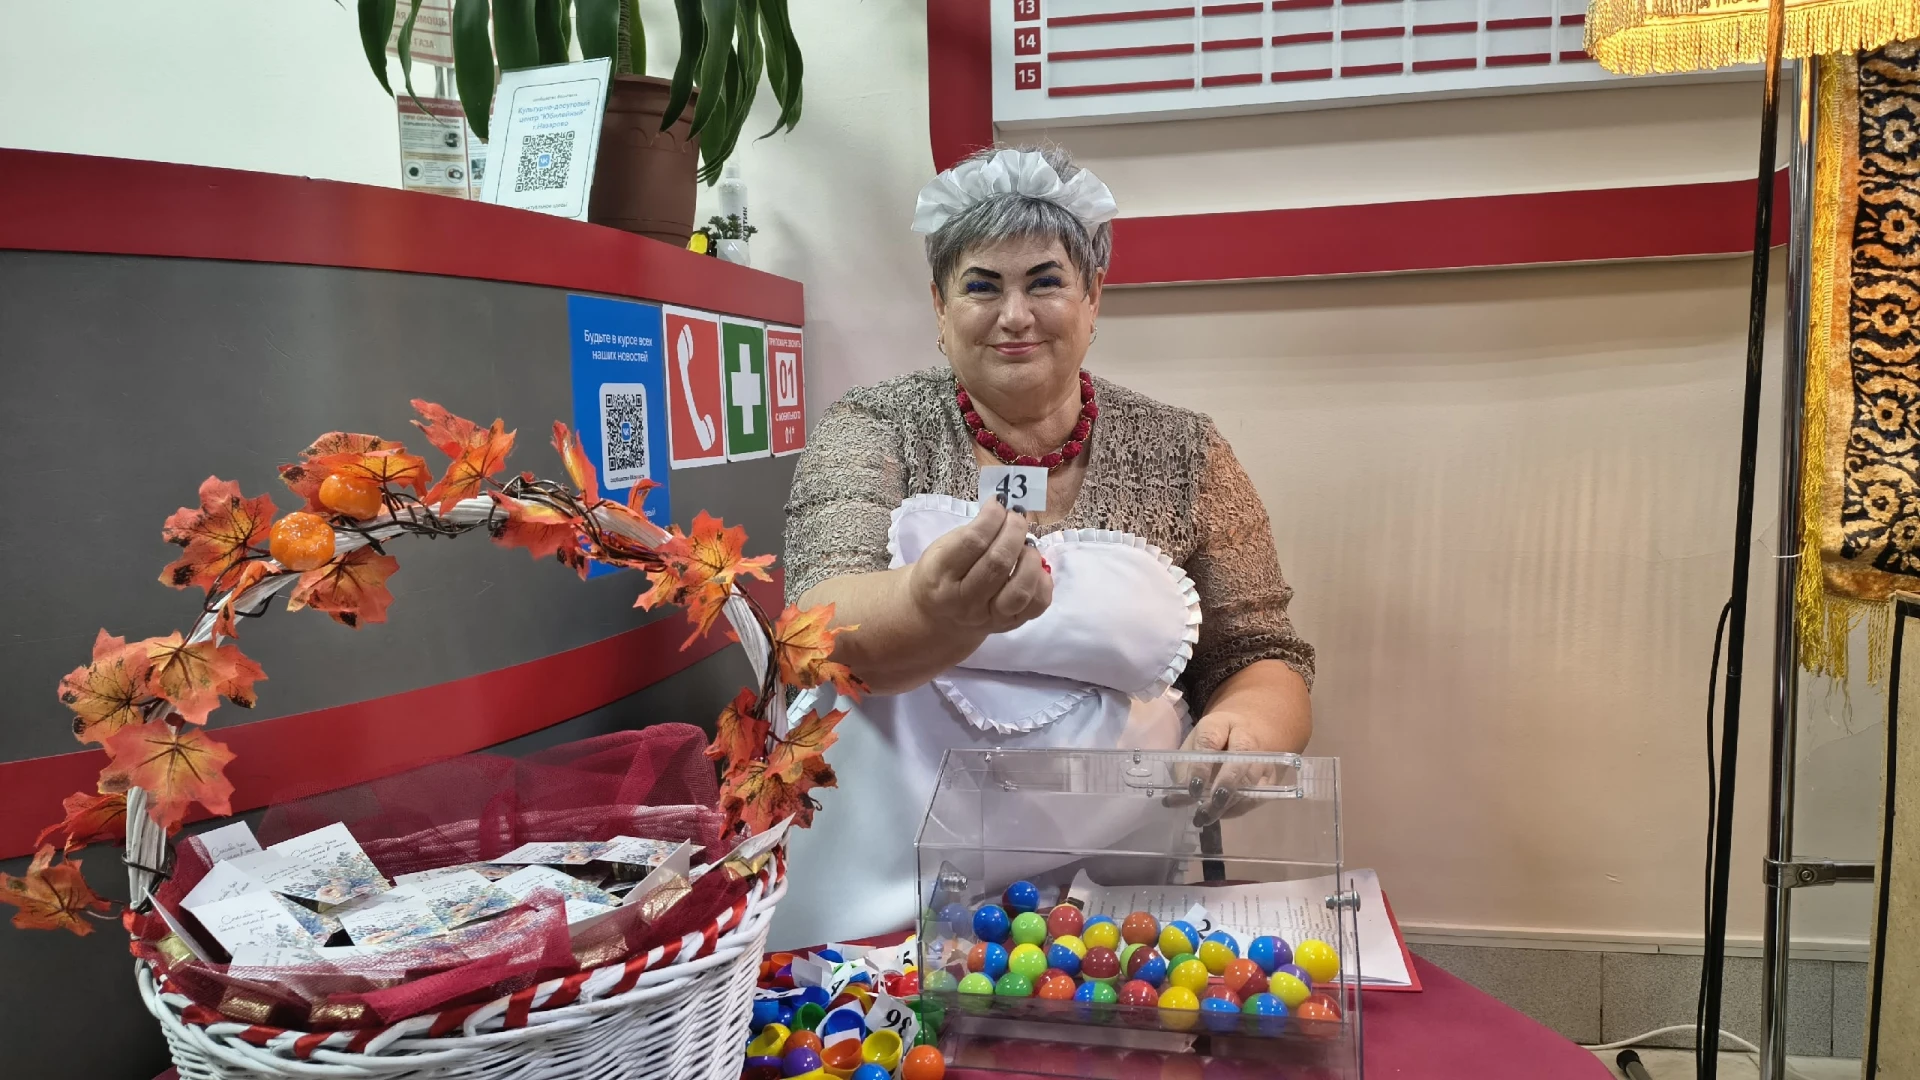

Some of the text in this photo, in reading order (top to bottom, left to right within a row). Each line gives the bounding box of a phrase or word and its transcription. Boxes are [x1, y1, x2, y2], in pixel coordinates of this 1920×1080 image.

[1016, 0, 1036, 15] 13
[1018, 34, 1036, 49] 14
[1018, 68, 1036, 84] 15
[519, 115, 540, 123] центр
[584, 330, 653, 347] Будьте в курсе всех
[592, 350, 649, 362] наших новостей
[780, 360, 794, 399] 01
[996, 473, 1028, 499] 43
